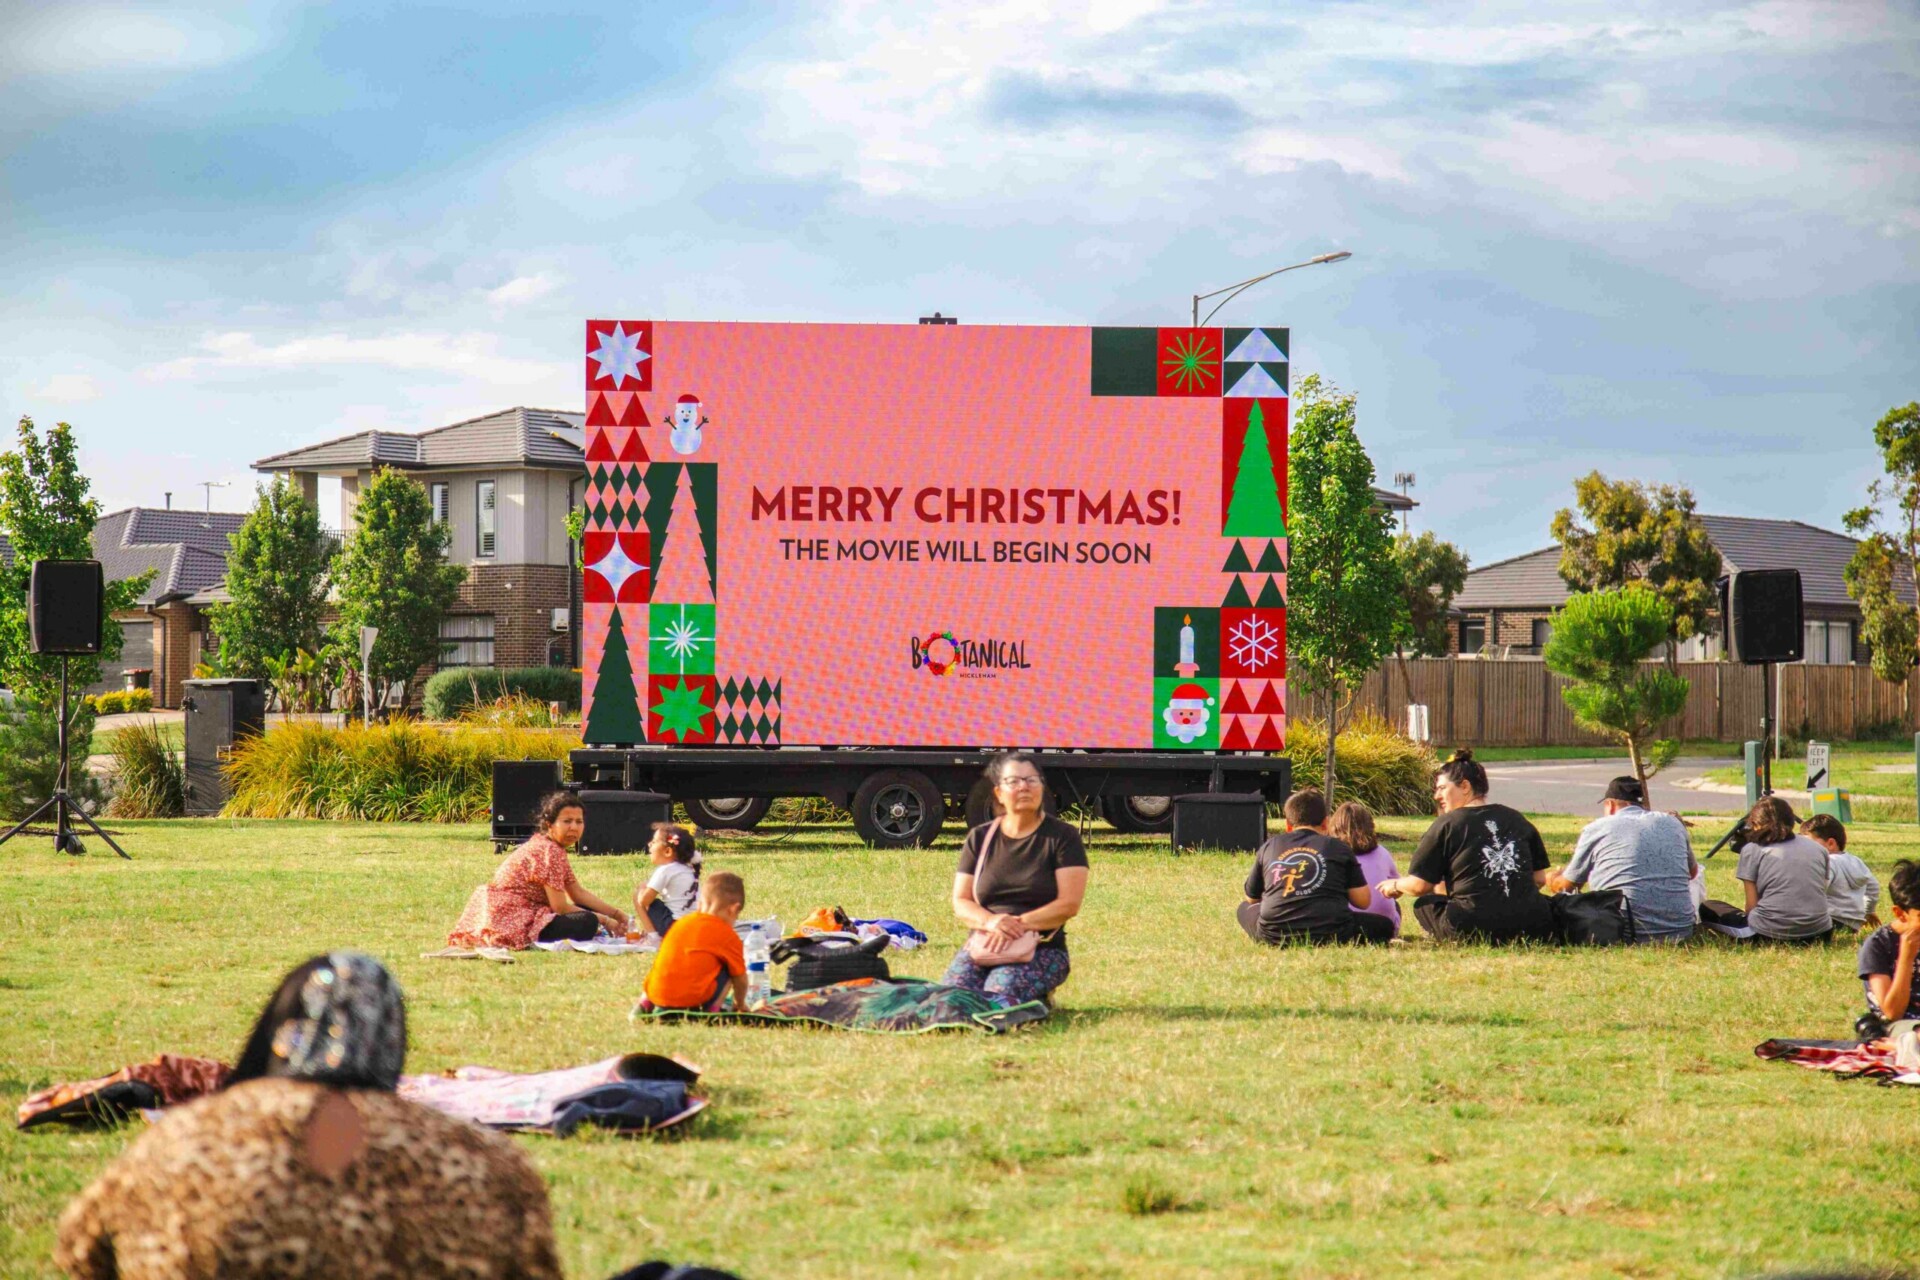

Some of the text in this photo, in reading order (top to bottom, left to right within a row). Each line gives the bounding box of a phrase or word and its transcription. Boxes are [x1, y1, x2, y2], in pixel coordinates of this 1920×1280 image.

[751, 485, 1181, 526] MERRY CHRISTMAS!
[779, 538, 1151, 565] THE MOVIE WILL BEGIN SOON
[911, 631, 1031, 676] BOTANICAL
